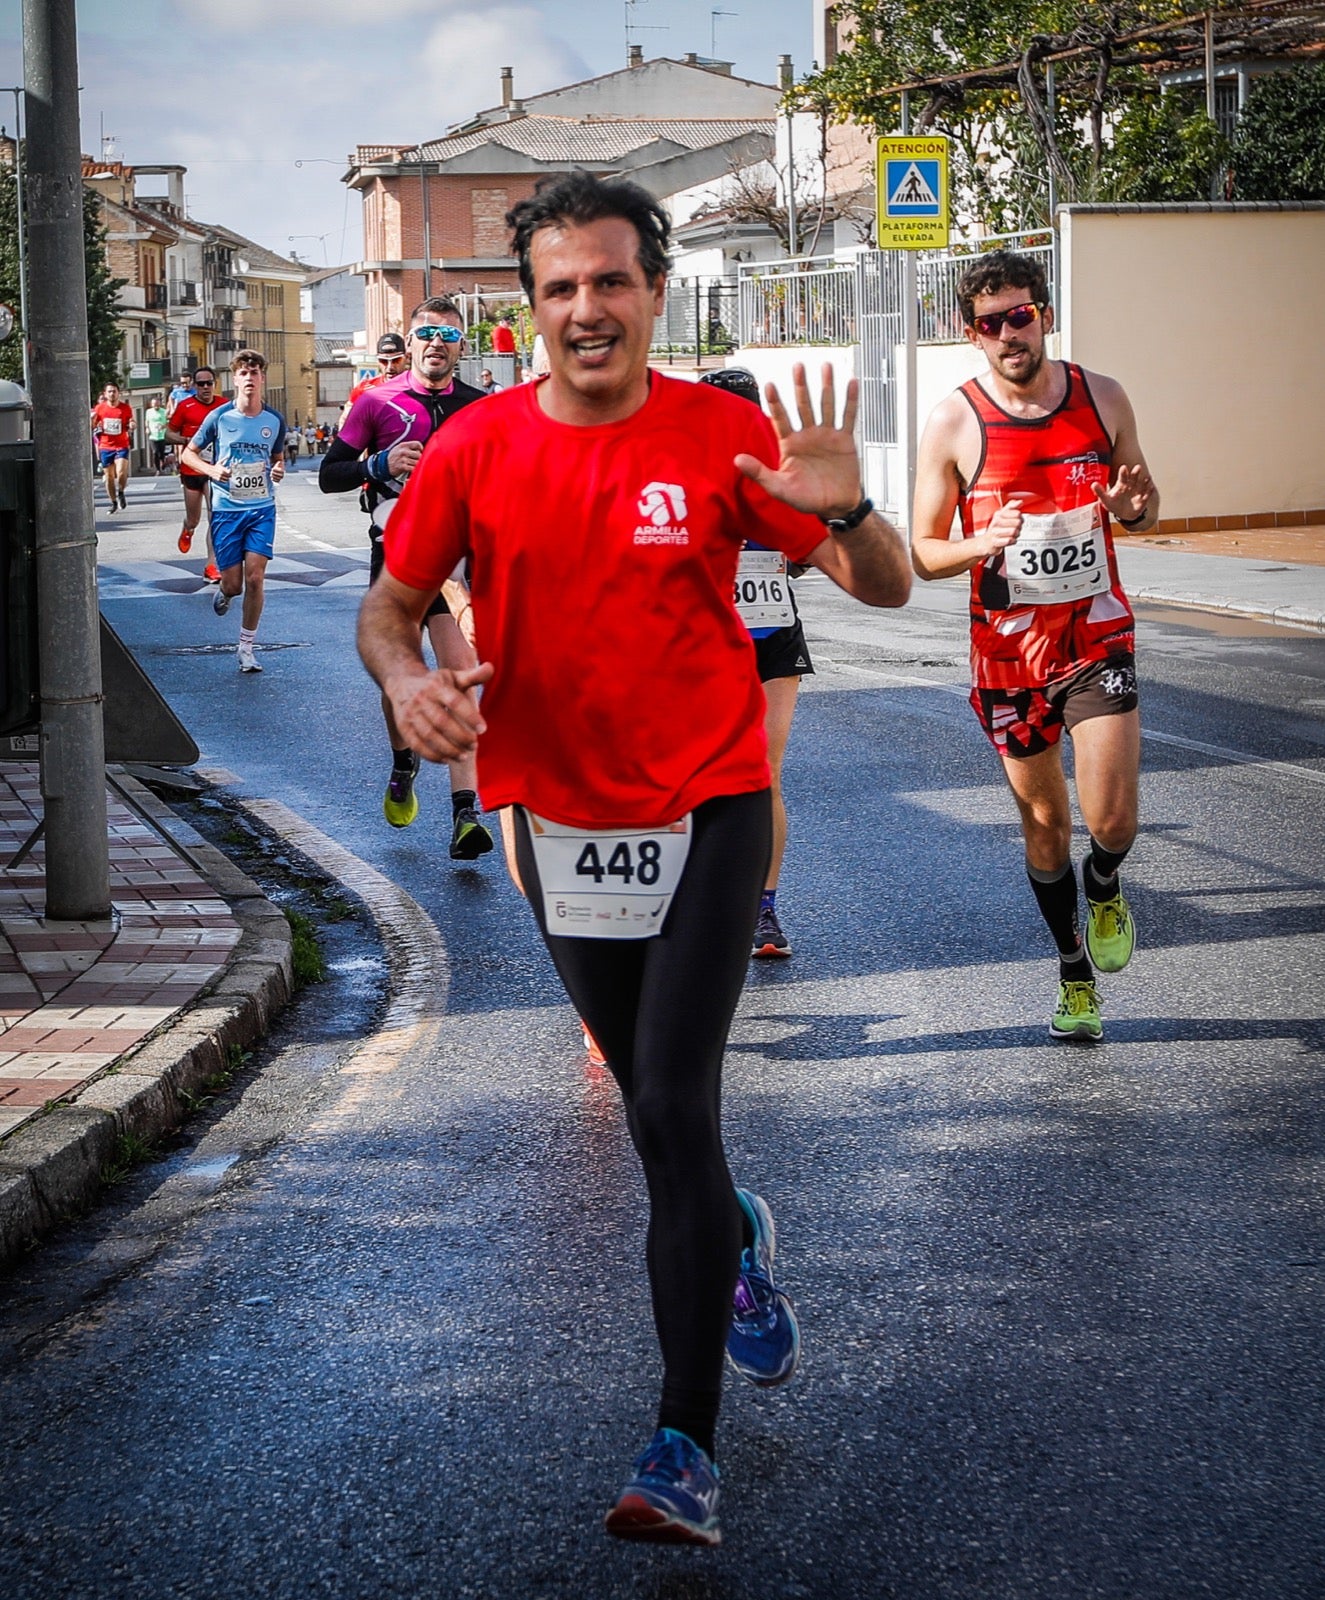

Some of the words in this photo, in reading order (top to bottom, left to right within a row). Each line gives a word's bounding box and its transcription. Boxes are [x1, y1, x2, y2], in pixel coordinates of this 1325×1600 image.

[881, 142, 945, 154] ATENCIÓN
[230, 442, 269, 450] ETIHAD
[235, 475, 264, 488] 3092
[633, 525, 689, 535] ARMILLA
[633, 535, 689, 545] DEPORTES
[1020, 538, 1096, 576] 3025
[575, 839, 661, 886] 448
